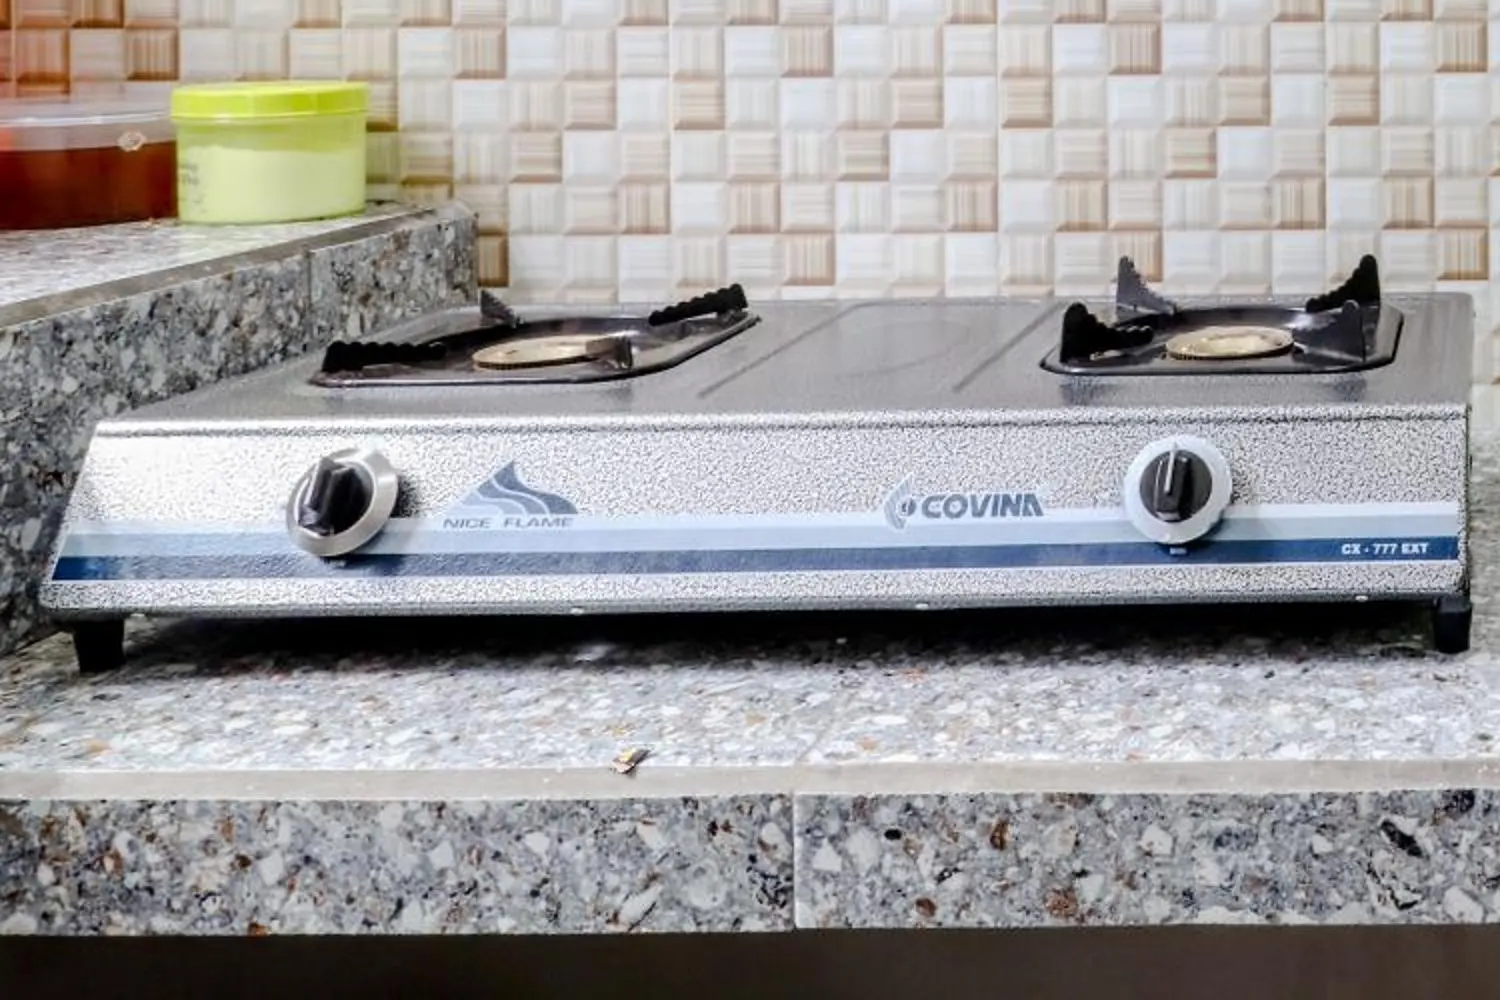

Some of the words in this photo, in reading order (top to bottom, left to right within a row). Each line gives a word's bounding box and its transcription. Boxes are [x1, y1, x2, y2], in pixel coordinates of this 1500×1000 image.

[921, 493, 1044, 519] COVINA
[443, 518, 492, 529] NICE
[504, 517, 575, 528] FLAME
[1341, 543, 1361, 555] CX
[1373, 542, 1398, 555] 777
[1401, 542, 1429, 555] EXT
